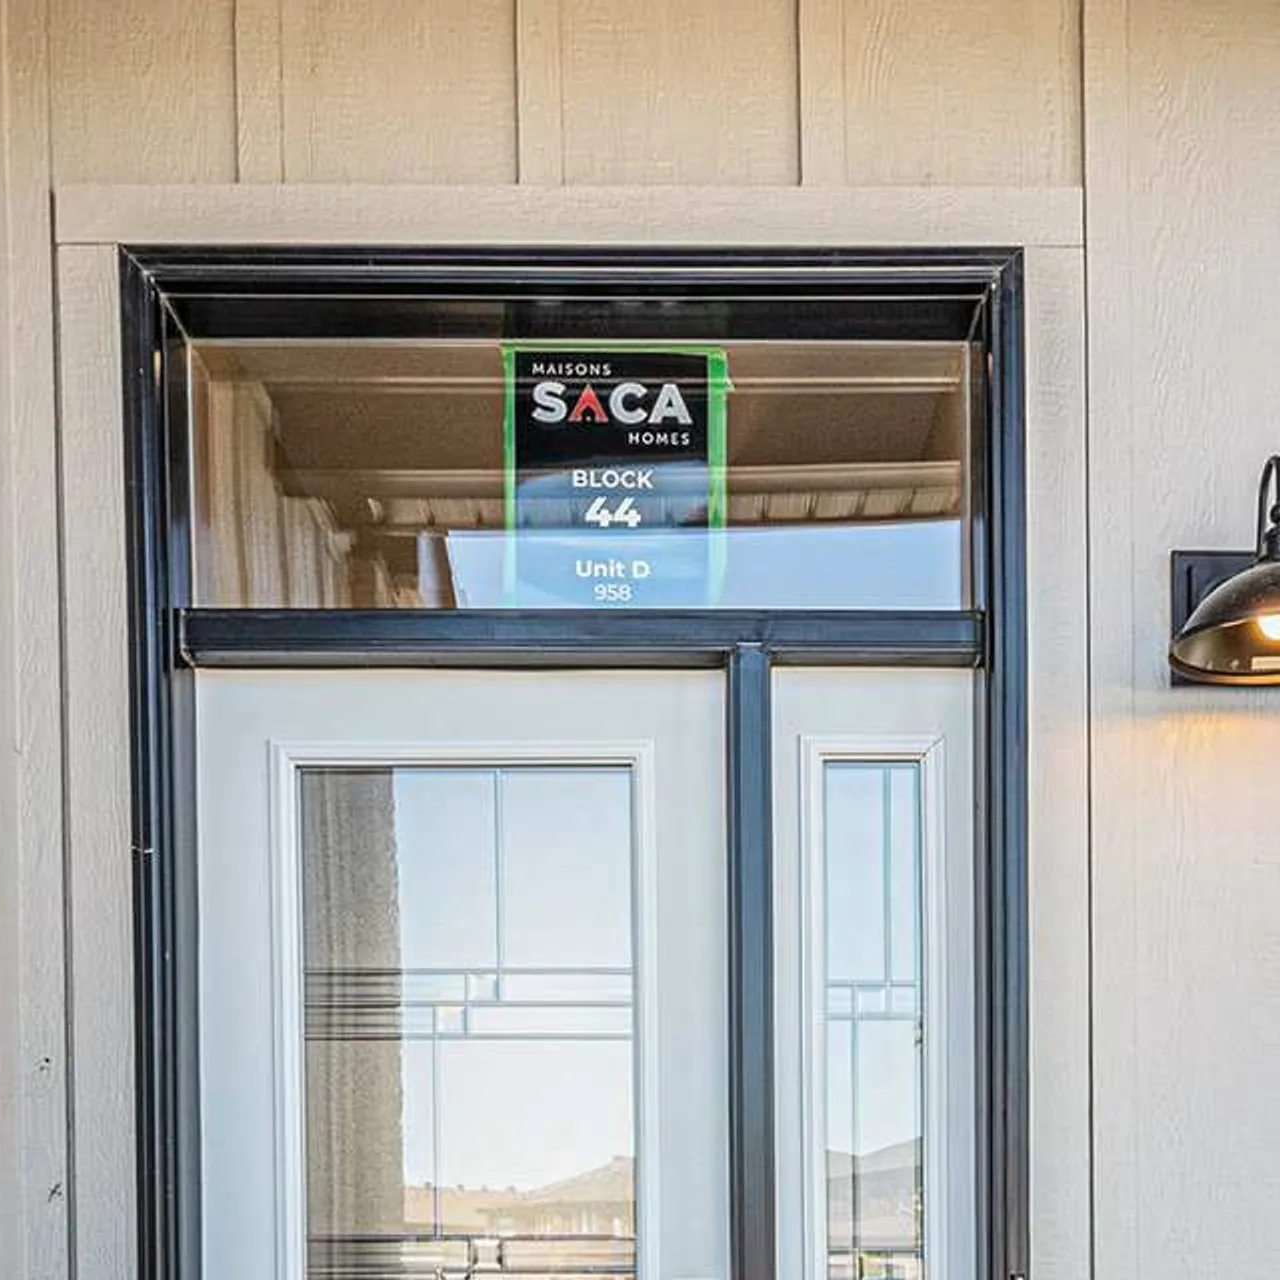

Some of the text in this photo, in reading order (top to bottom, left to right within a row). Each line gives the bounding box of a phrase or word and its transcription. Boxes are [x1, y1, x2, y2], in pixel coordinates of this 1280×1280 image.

[531, 362, 612, 376] MAISONS
[531, 381, 693, 424] SACA
[627, 432, 691, 446] HOMES
[572, 469, 654, 489] BLOCK
[584, 496, 642, 527] 44
[575, 558, 651, 578] Unit D
[593, 583, 632, 602] 958
